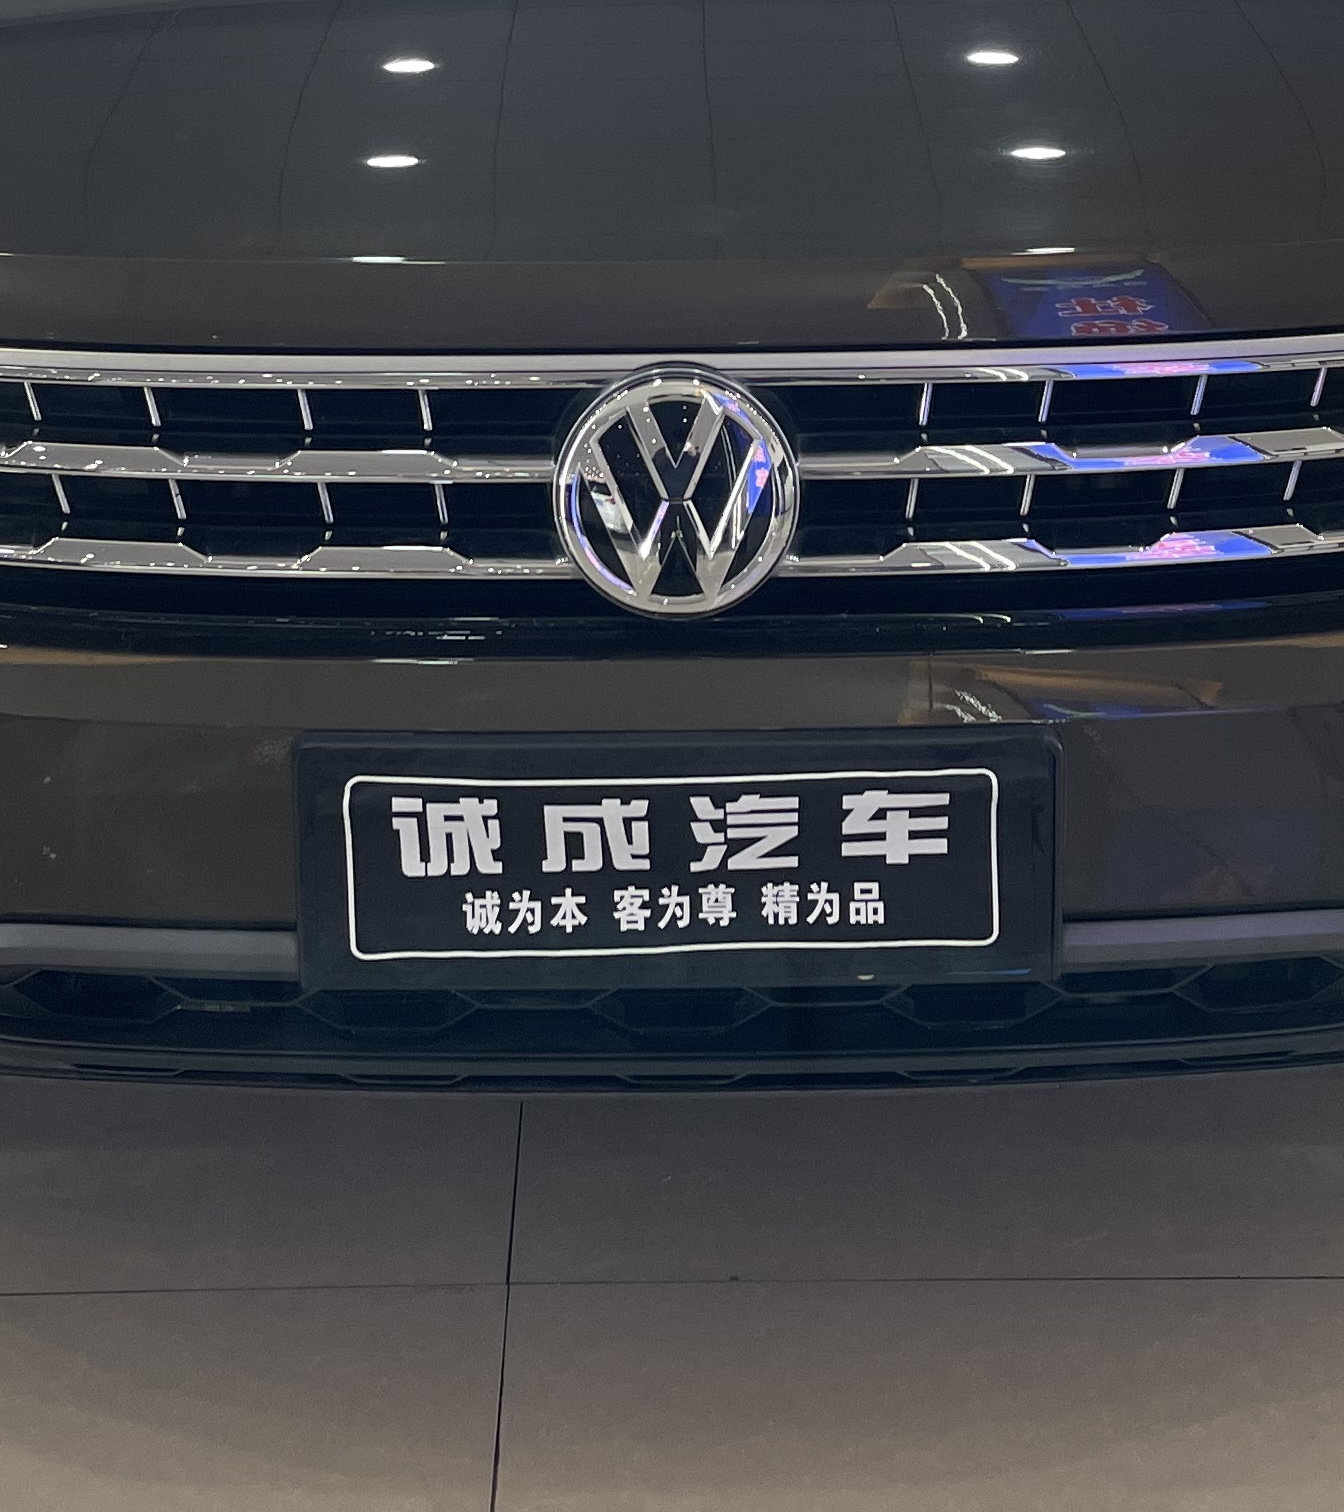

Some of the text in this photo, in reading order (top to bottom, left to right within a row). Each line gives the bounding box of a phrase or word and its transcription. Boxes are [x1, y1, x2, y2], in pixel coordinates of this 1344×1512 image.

[391, 789, 951, 877] 诚成汽车
[462, 881, 885, 935] 诚为本 客为尊 精为品
